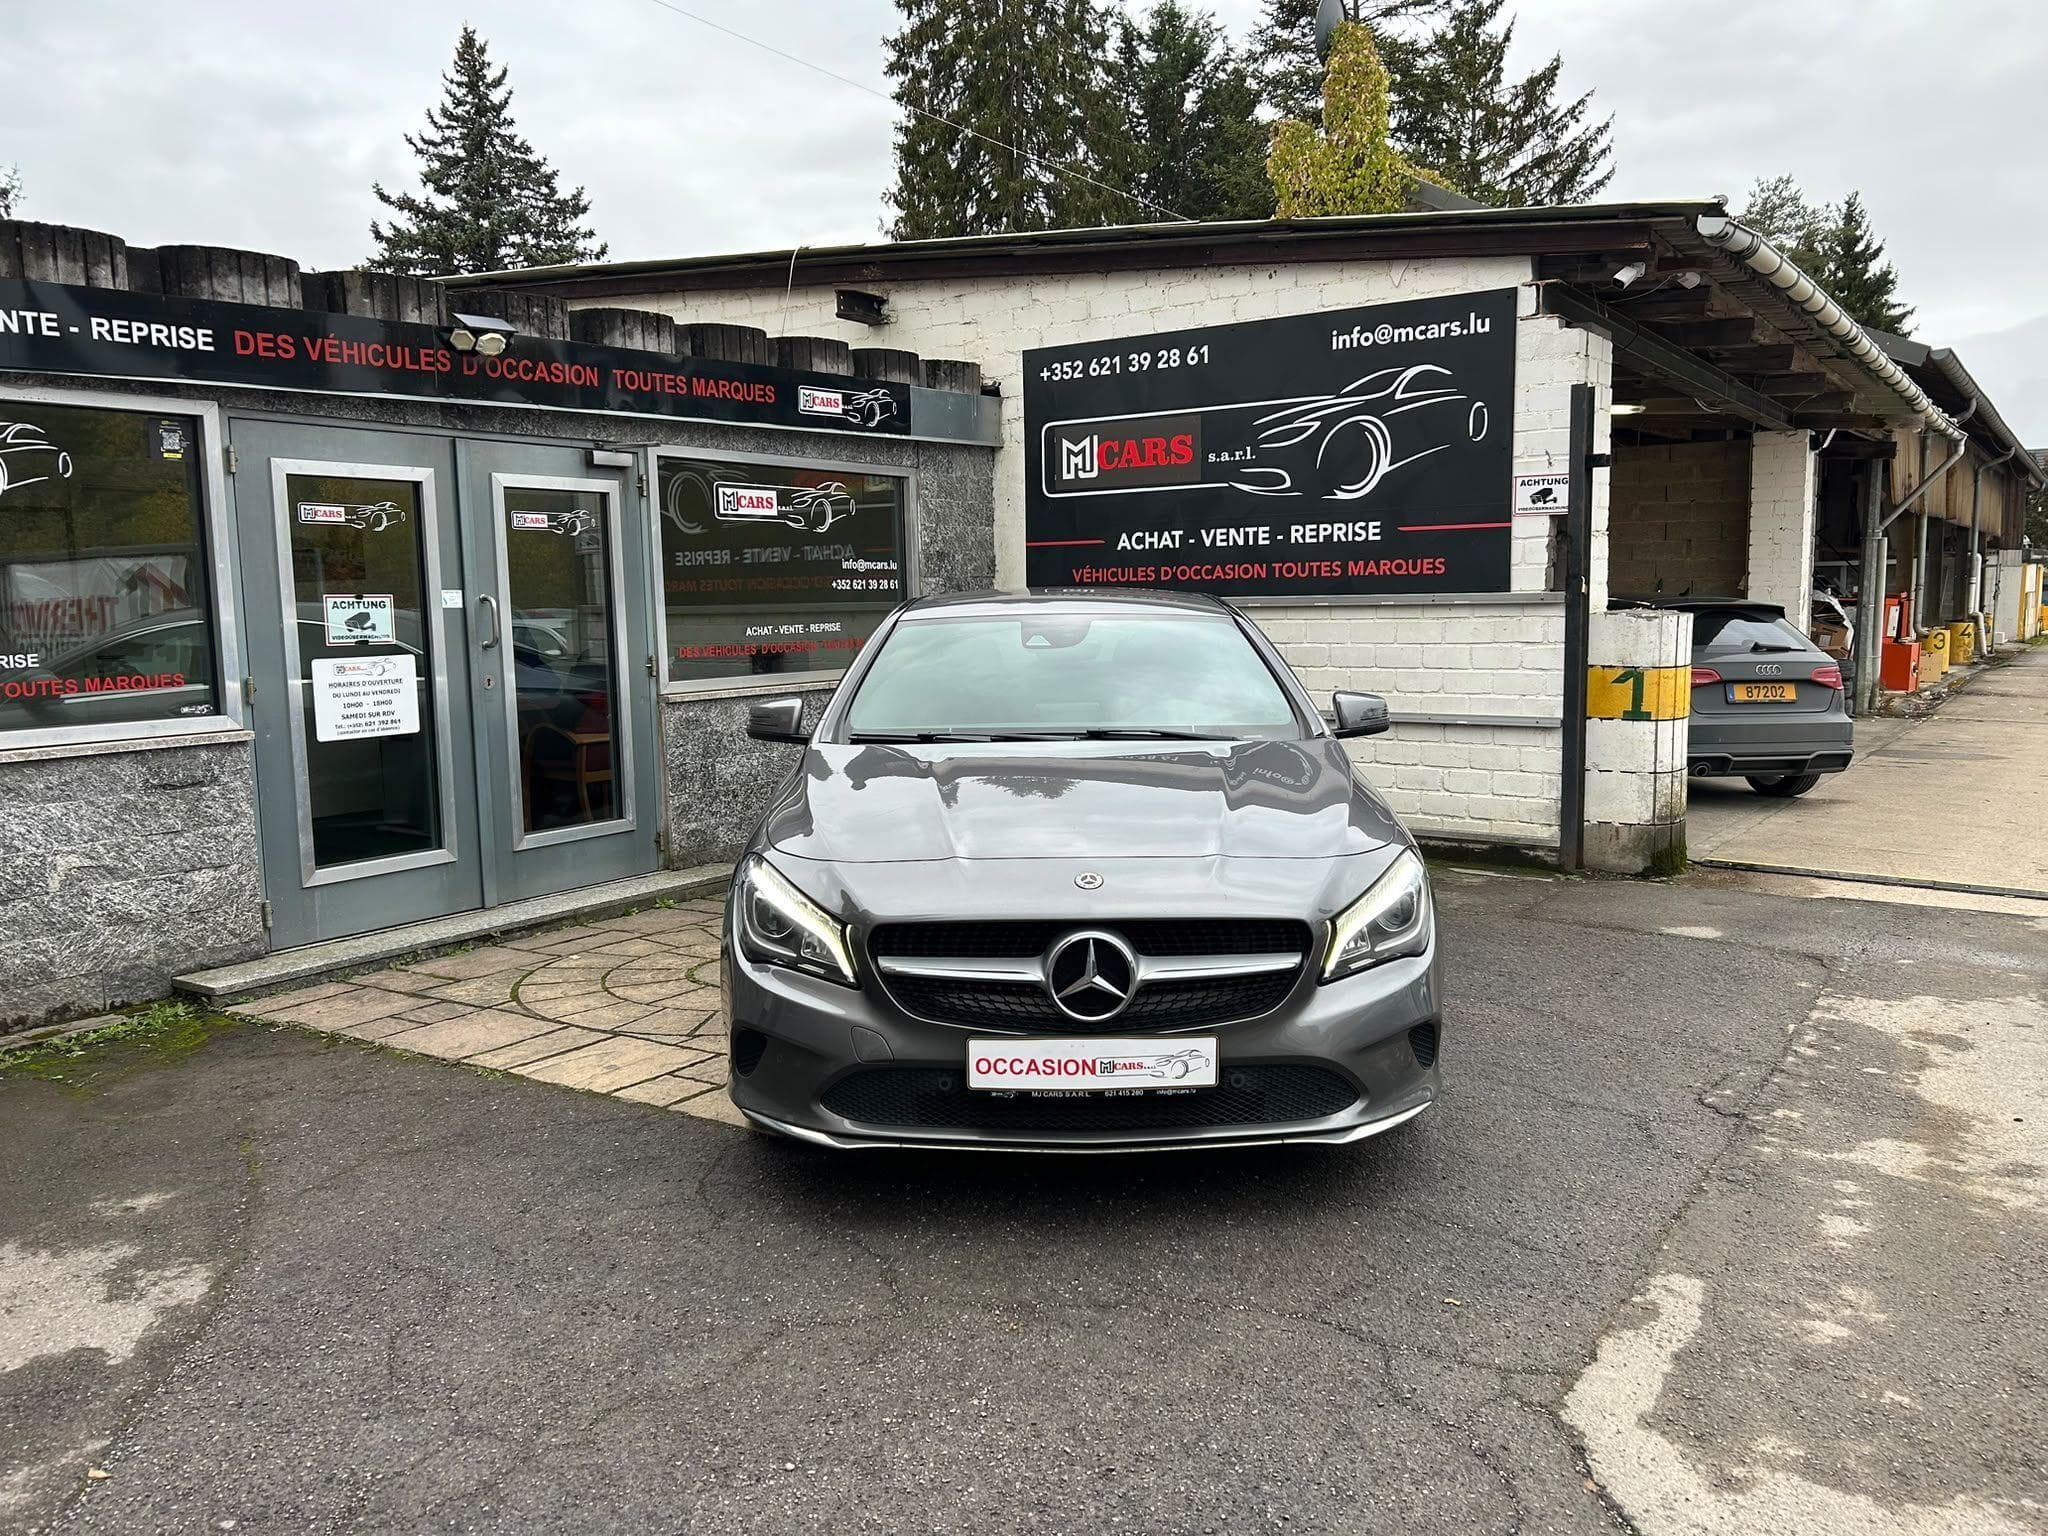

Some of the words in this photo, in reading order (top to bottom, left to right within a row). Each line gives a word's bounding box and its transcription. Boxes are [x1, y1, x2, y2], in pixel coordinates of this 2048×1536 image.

[1331, 311, 1490, 350] info@mcars.lu
[0, 309, 60, 337] NTE
[90, 316, 215, 352] REPRISE
[234, 329, 296, 359] DES
[303, 333, 451, 372] VÉHICULES
[612, 369, 688, 395] TOUTES
[692, 377, 776, 403] MARQUES
[1040, 360, 1084, 382] +352
[1089, 355, 1121, 377] 621
[1128, 352, 1151, 372] 39
[1157, 348, 1180, 369] 28
[1186, 344, 1209, 366] 61
[1208, 446, 1257, 463] s.a.r.l.
[1520, 477, 1568, 487] ACHTUNG
[1116, 530, 1184, 551] ACHAT
[1200, 526, 1270, 548] VENTE
[1290, 521, 1381, 545] REPRISE
[842, 559, 897, 572] info@mcars.lu
[1072, 565, 1155, 583] VÉHICULES
[1160, 563, 1267, 582] D'OCCASION
[1272, 560, 1342, 579] TOUTES
[1348, 558, 1446, 577] MARQUES
[831, 579, 851, 590] +352
[853, 579, 867, 590] 621
[868, 579, 878, 590] 39
[879, 579, 889, 590] 28
[889, 579, 898, 590] 61
[331, 600, 386, 610] ACHTUNG
[745, 625, 773, 637] ACHAT
[779, 624, 805, 635] VENTE
[810, 622, 841, 633] REPRISE
[1960, 624, 1972, 638] 4
[1933, 632, 1946, 650] 3
[680, 646, 700, 658] DES
[0, 678, 79, 698] OUTES
[85, 673, 185, 693] MARQUES
[328, 681, 361, 689] HORAIRES
[371, 688, 401, 696] VENDREDI
[1745, 685, 1786, 699] 87202
[1610, 668, 1652, 721] 1
[341, 712, 367, 720] SAMEDI
[975, 1057, 1096, 1076] OCCASION
